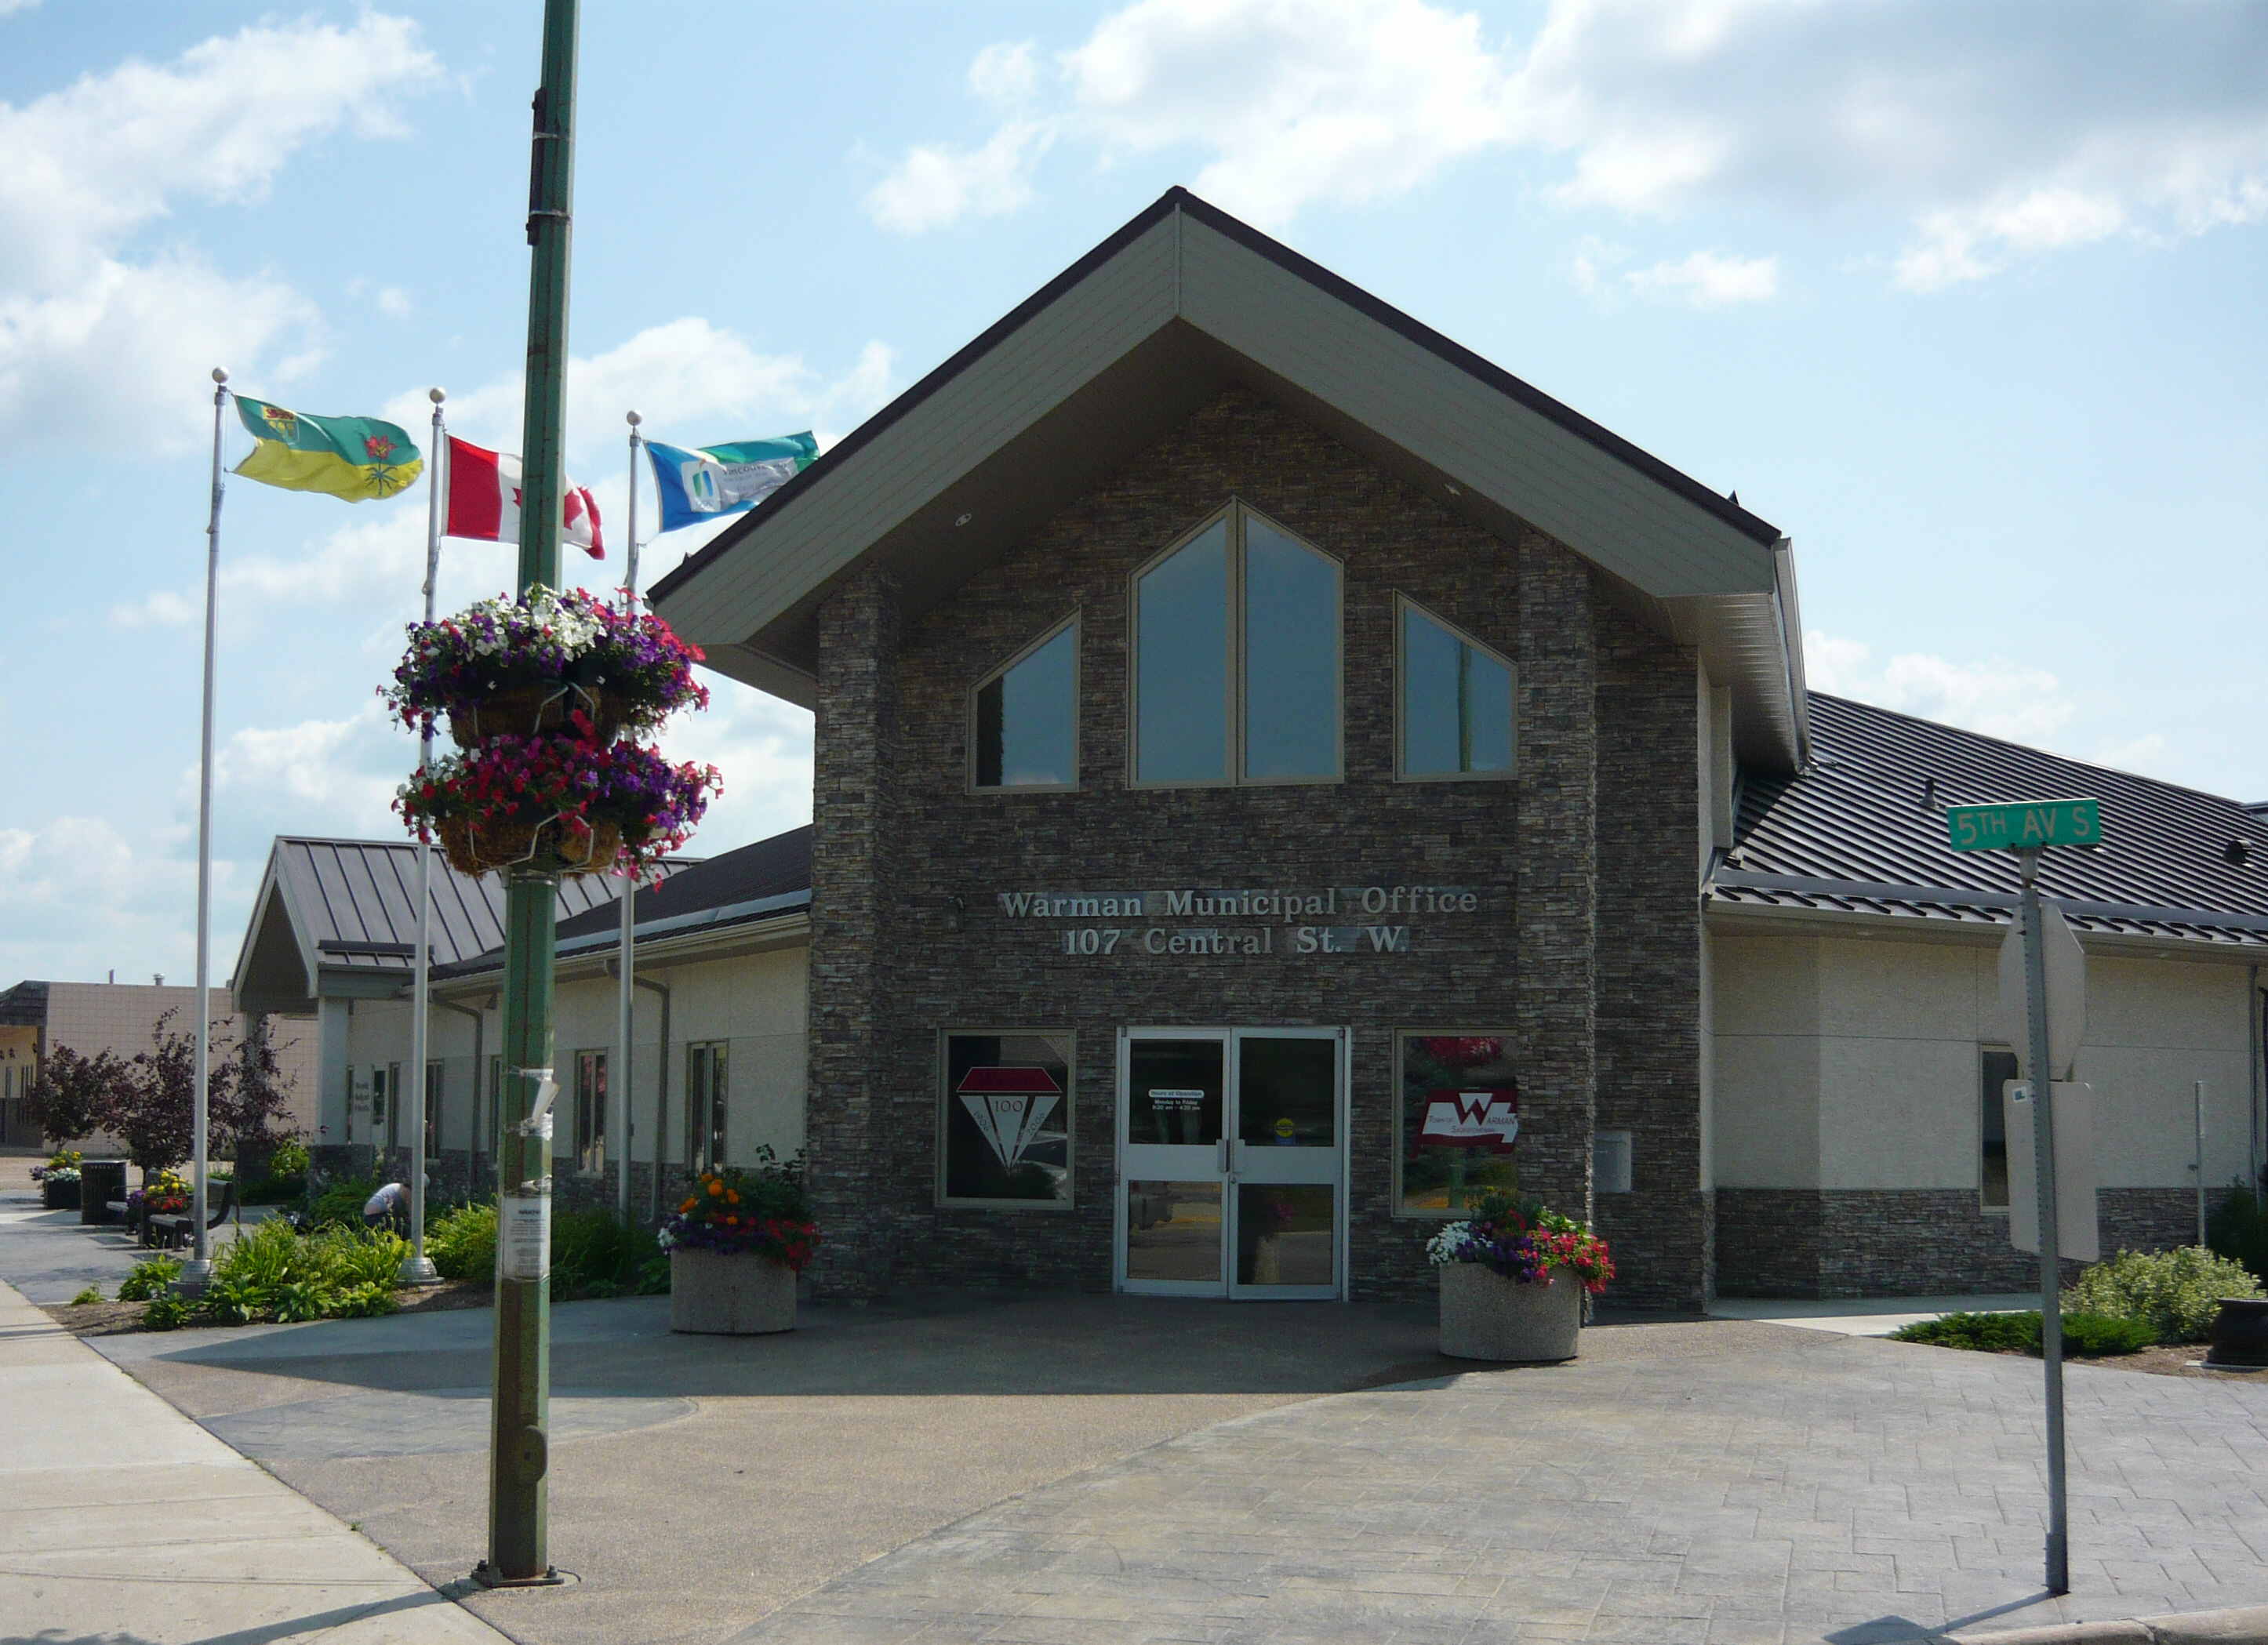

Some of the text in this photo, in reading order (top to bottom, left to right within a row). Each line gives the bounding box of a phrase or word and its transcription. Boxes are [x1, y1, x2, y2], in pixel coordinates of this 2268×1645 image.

[1957, 805, 2090, 845] 5TH AV S
[1001, 886, 1477, 924] Warman Municipal Office
[1066, 926, 1406, 956] 107 Central St. W.
[995, 1100, 1023, 1113] 100
